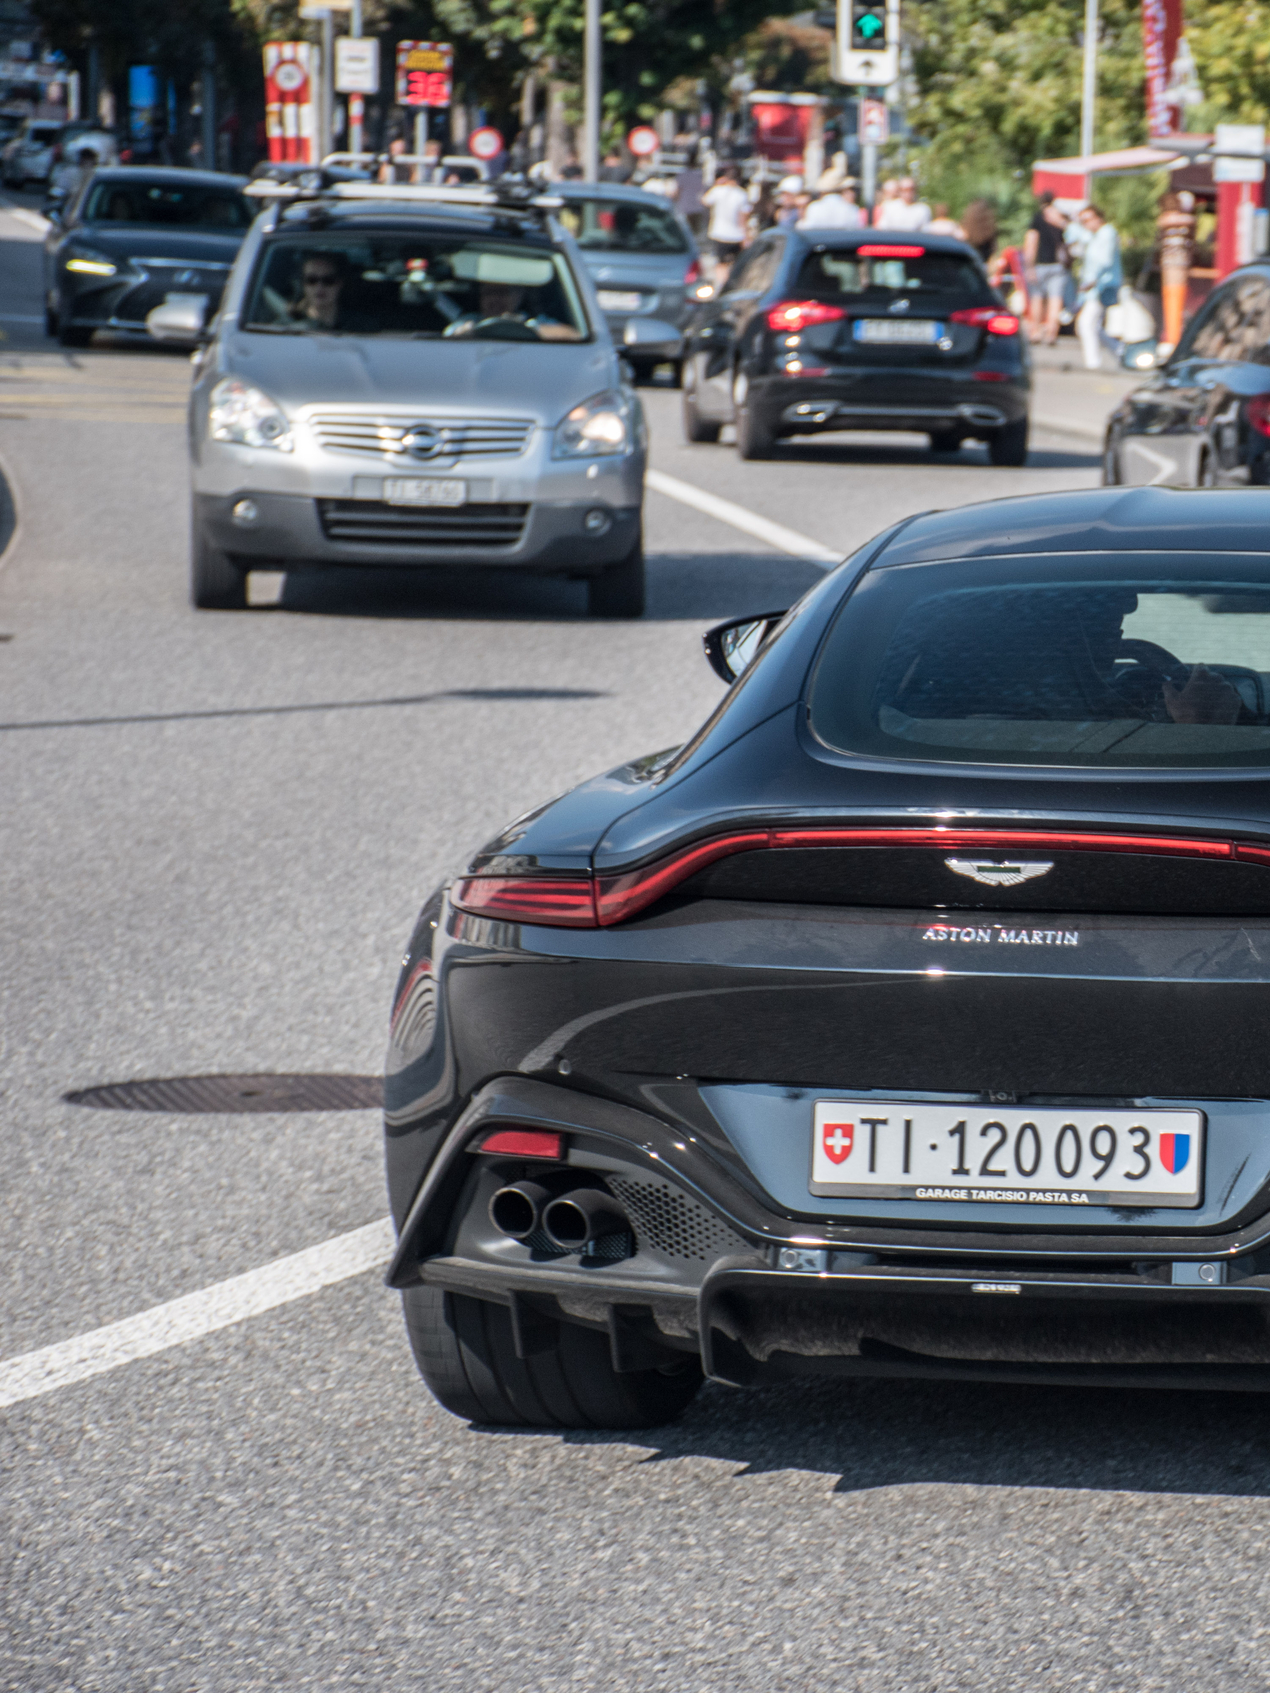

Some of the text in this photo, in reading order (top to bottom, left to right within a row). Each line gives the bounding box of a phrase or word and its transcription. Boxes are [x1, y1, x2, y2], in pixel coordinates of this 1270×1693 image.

[922, 928, 1079, 946] ASTON MARTIN
[915, 1187, 1089, 1204] GARAGE TARCISIO PASTA SA
